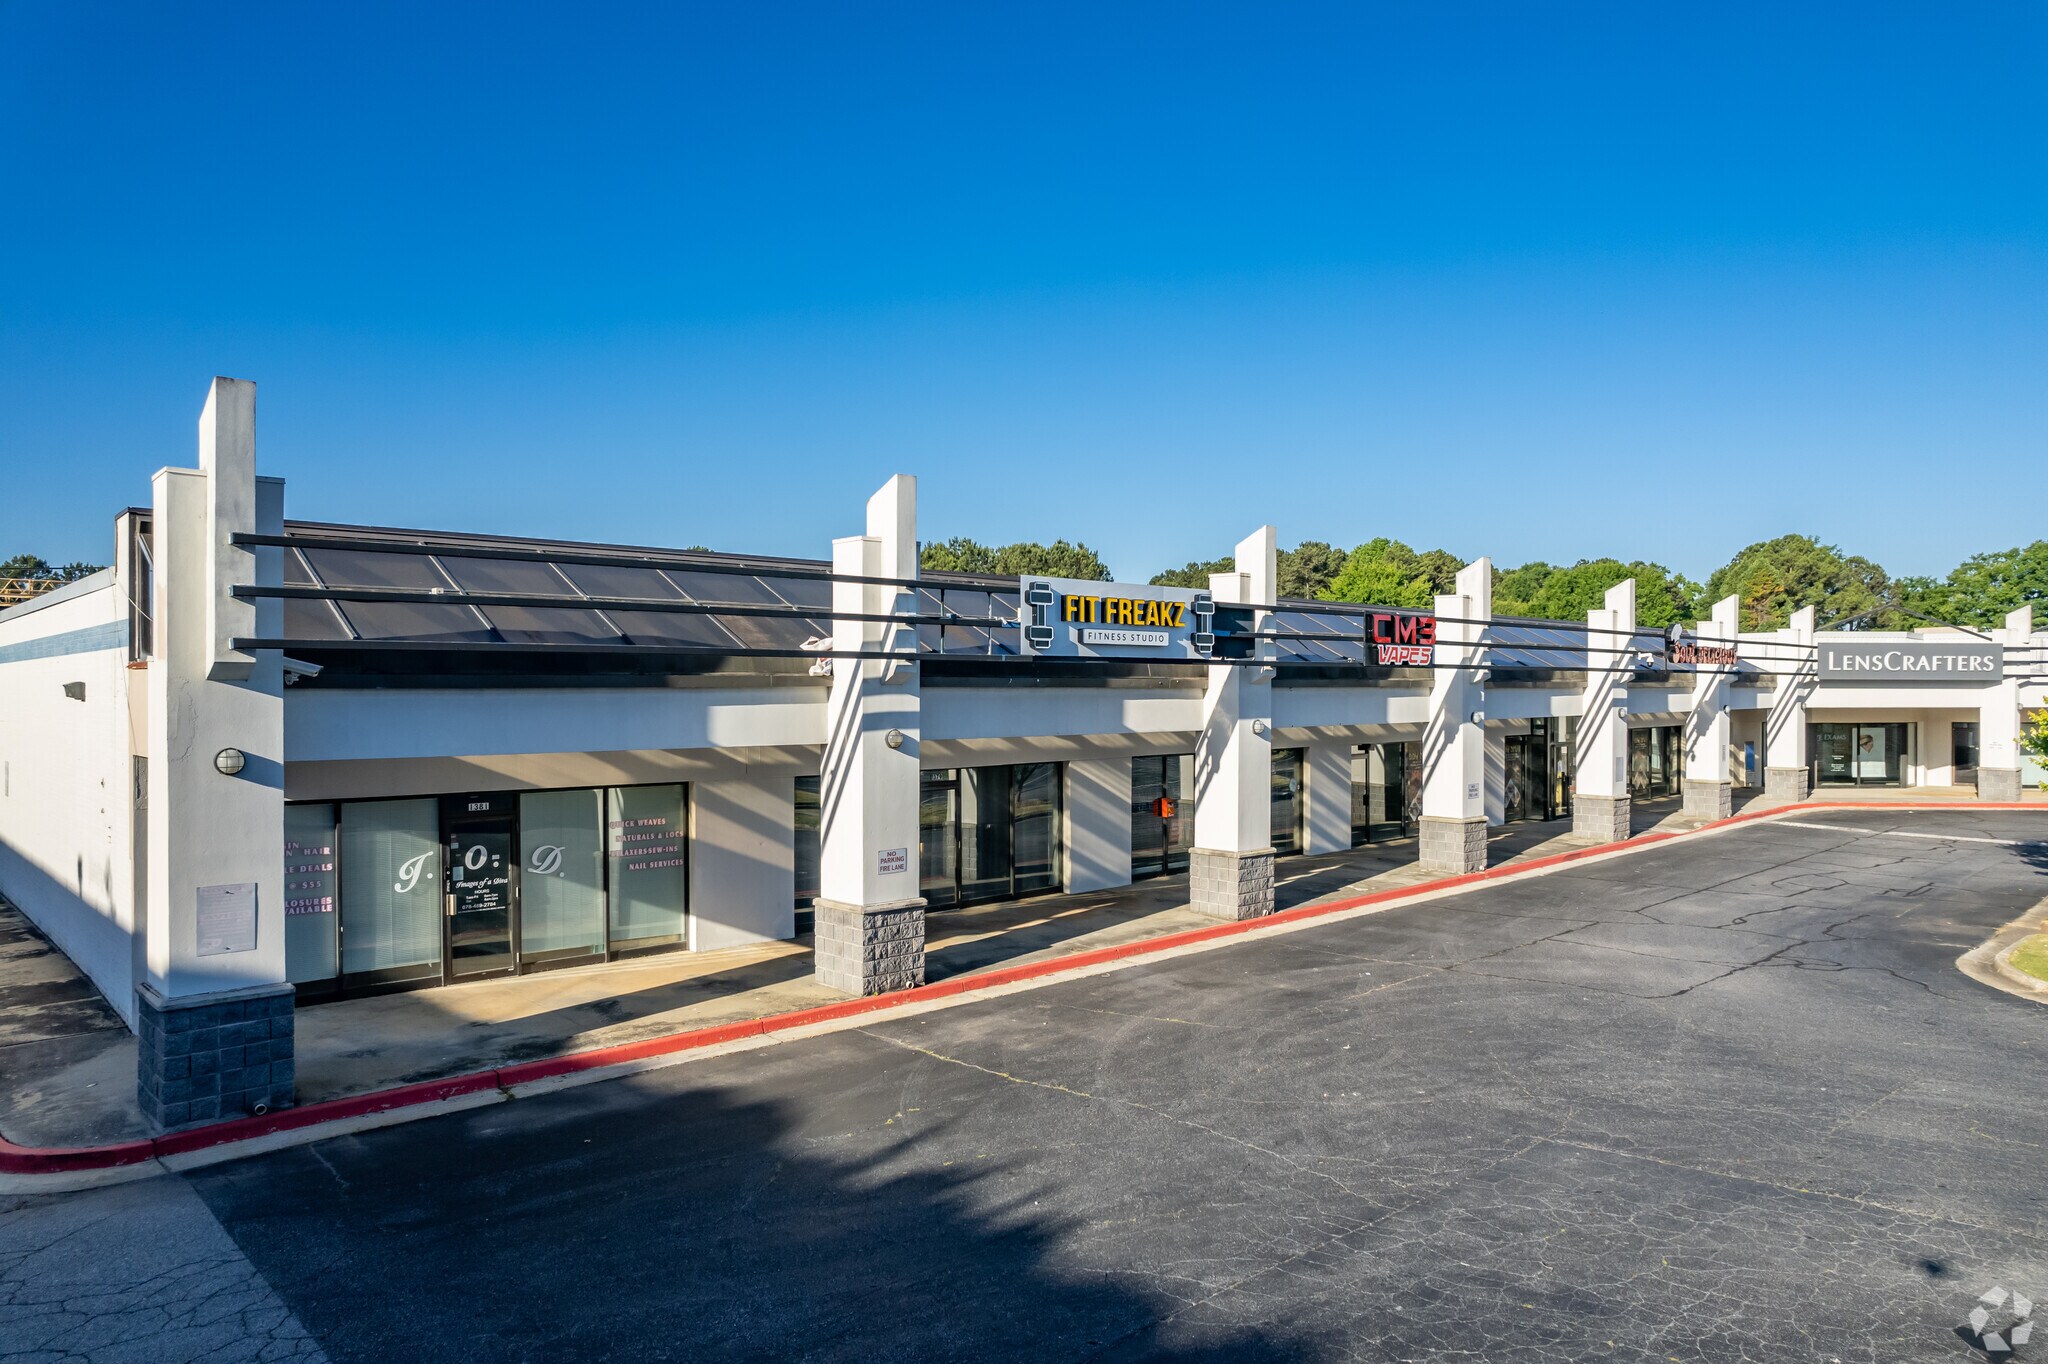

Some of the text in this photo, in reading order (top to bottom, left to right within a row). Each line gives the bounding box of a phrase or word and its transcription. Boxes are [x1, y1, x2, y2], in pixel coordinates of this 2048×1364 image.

[1064, 594, 1186, 628] FIT FREAKZ
[1372, 614, 1437, 645] CM3
[1087, 631, 1165, 643] FITNESS STUDIO
[1377, 644, 1433, 666] VAPES
[469, 803, 489, 811] 1381
[637, 818, 666, 827] WEAVES
[616, 832, 655, 842] NATURALS
[304, 847, 330, 855] HAIR
[629, 859, 684, 870] NAIL SERVICES
[880, 856, 904, 864] PARKING
[300, 863, 333, 872] DEALS
[455, 881, 478, 889] Images
[477, 877, 489, 889] of
[284, 896, 332, 907] LOSURES
